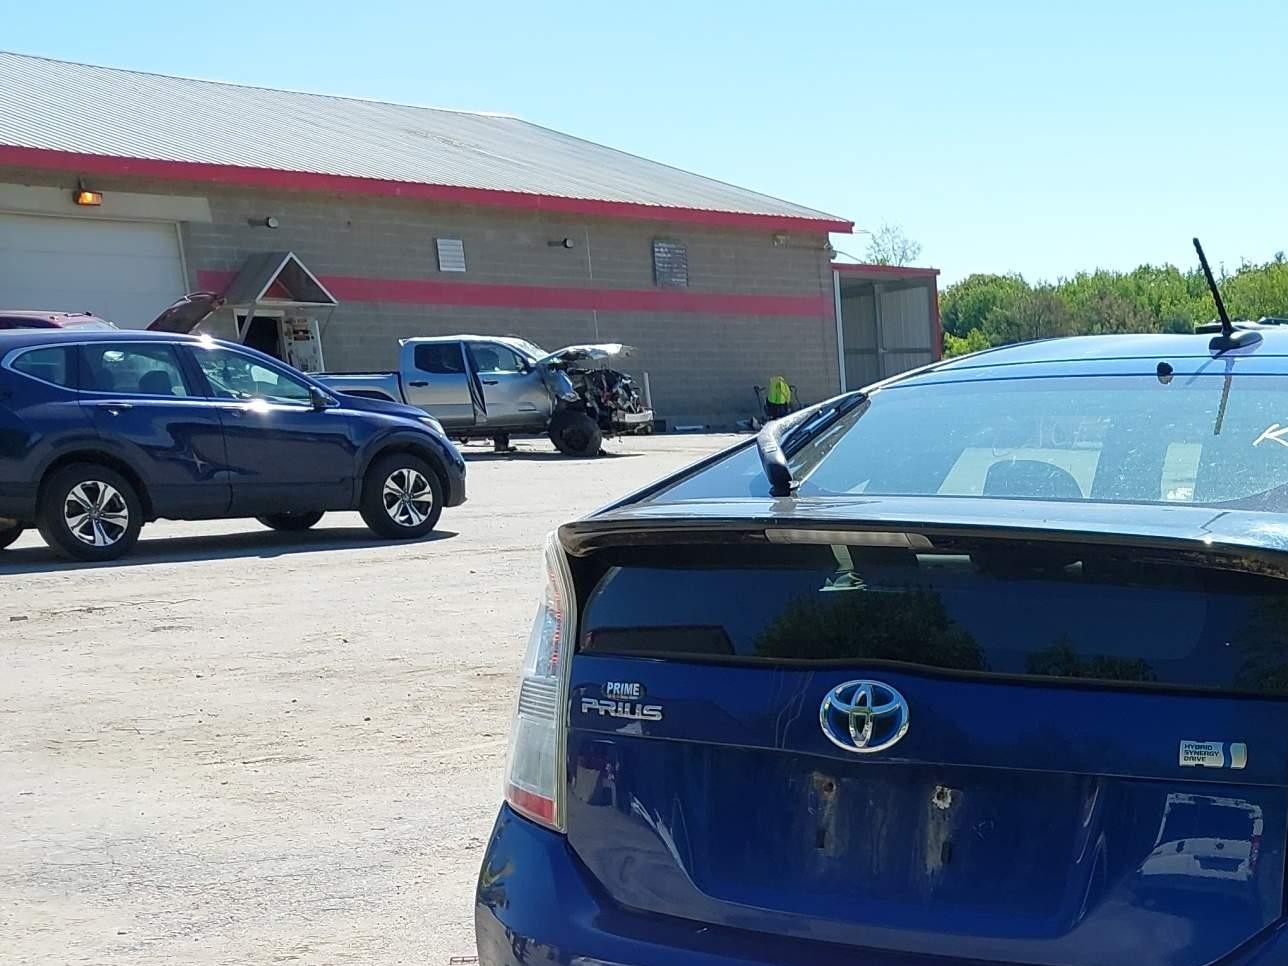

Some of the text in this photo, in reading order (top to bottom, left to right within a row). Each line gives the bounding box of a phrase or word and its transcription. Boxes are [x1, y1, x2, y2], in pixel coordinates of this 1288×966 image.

[606, 681, 641, 697] PRIME
[581, 697, 663, 721] PRIUS
[1183, 743, 1213, 751] HYBRID
[1183, 749, 1220, 757] SYNERGY
